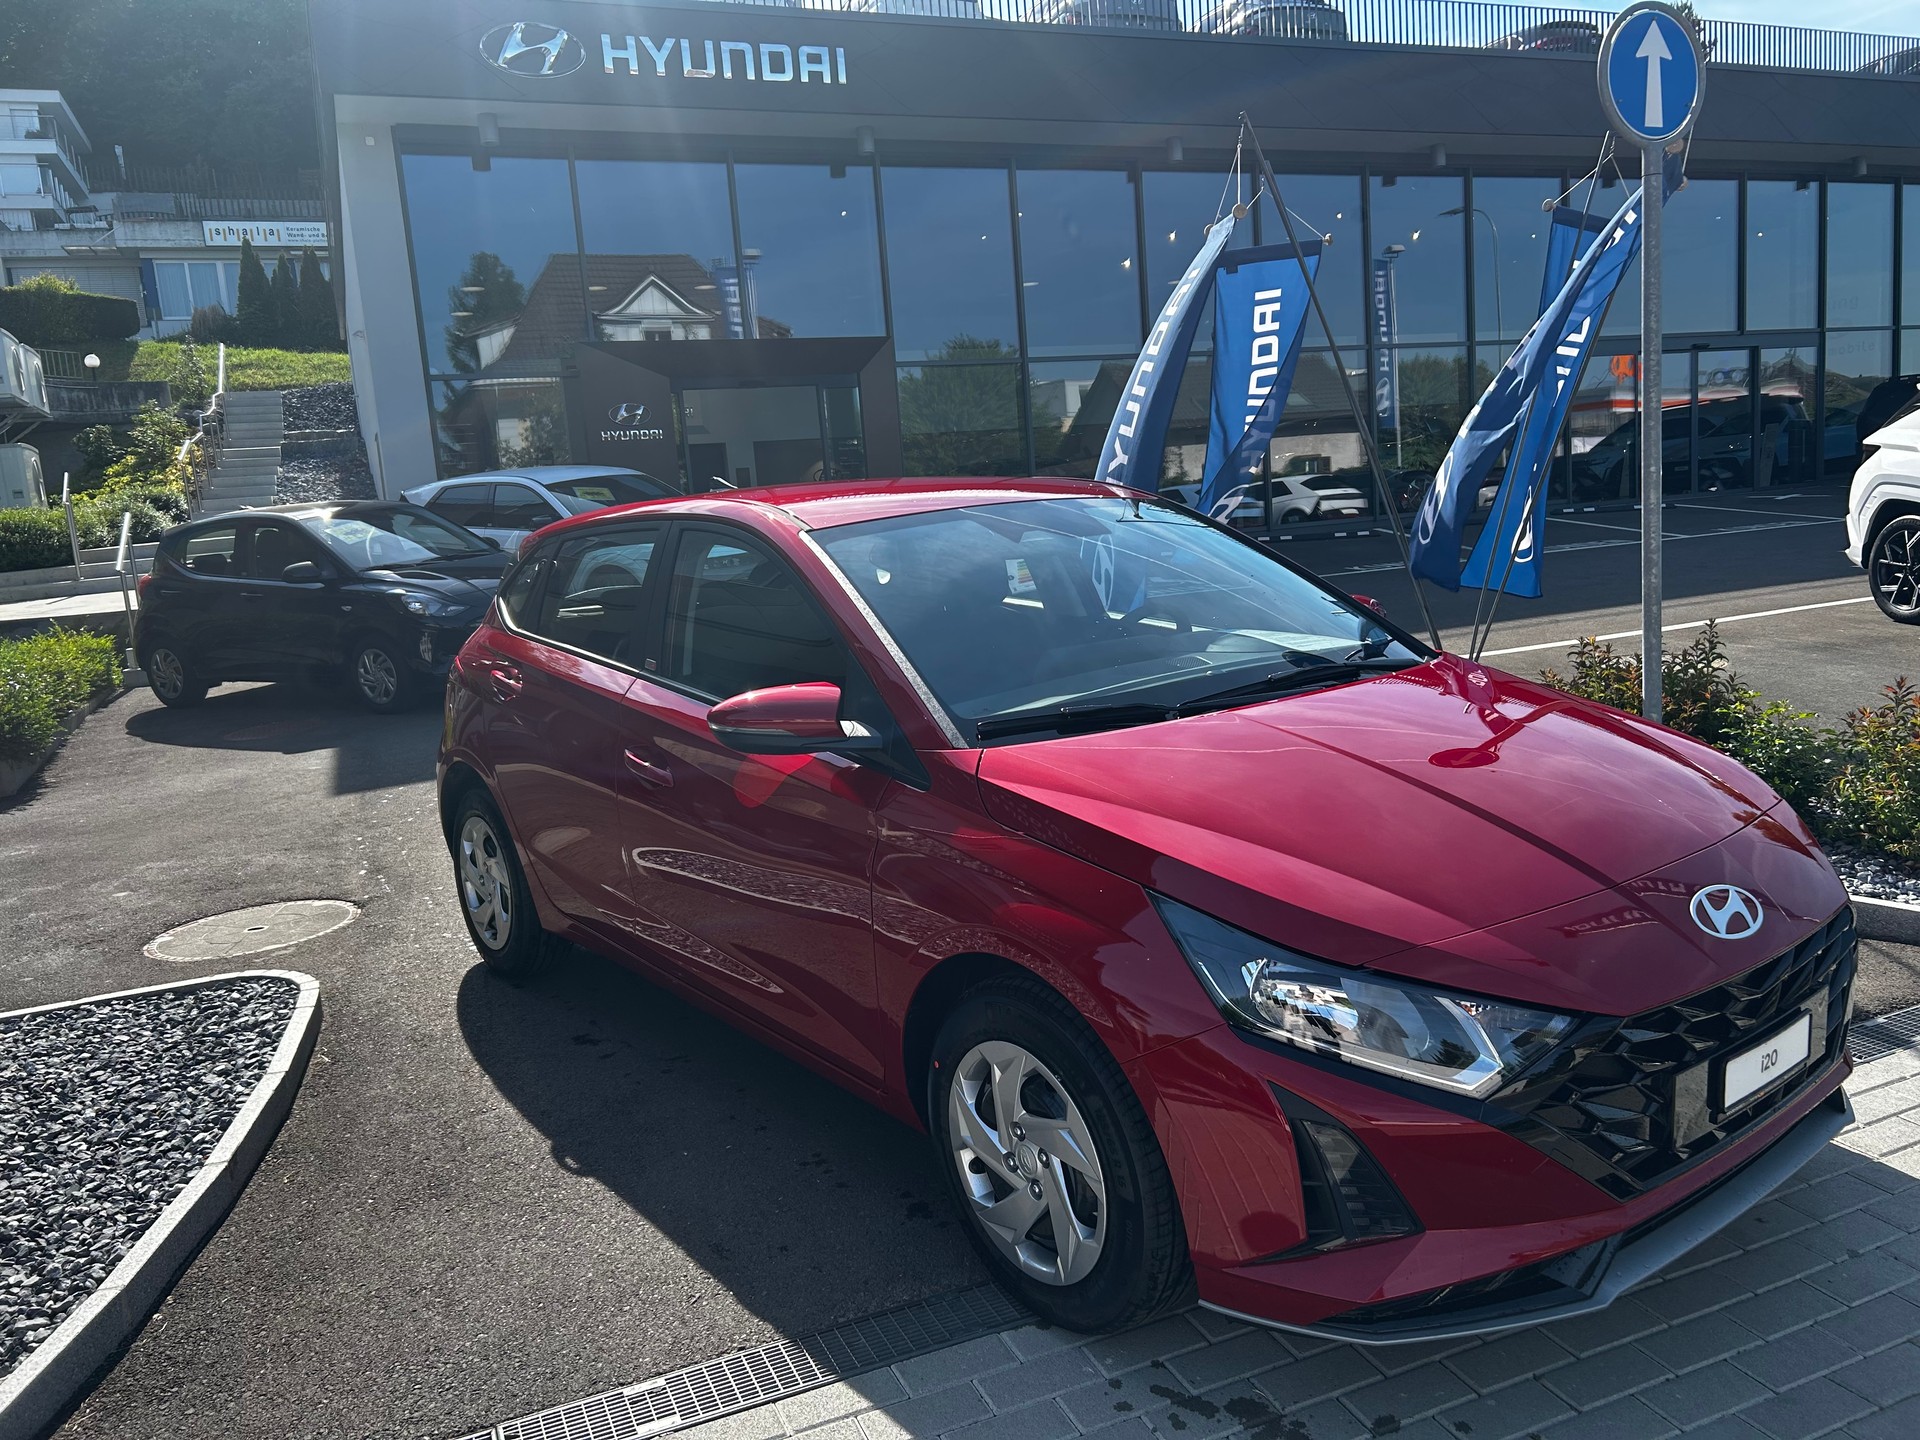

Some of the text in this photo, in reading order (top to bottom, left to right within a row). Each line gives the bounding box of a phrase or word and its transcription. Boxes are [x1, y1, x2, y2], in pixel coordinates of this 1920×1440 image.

[600, 33, 847, 84] HYUNDAI
[214, 226, 275, 236] shala
[600, 429, 663, 441] HYUNDAI
[1760, 1048, 1779, 1074] i20
